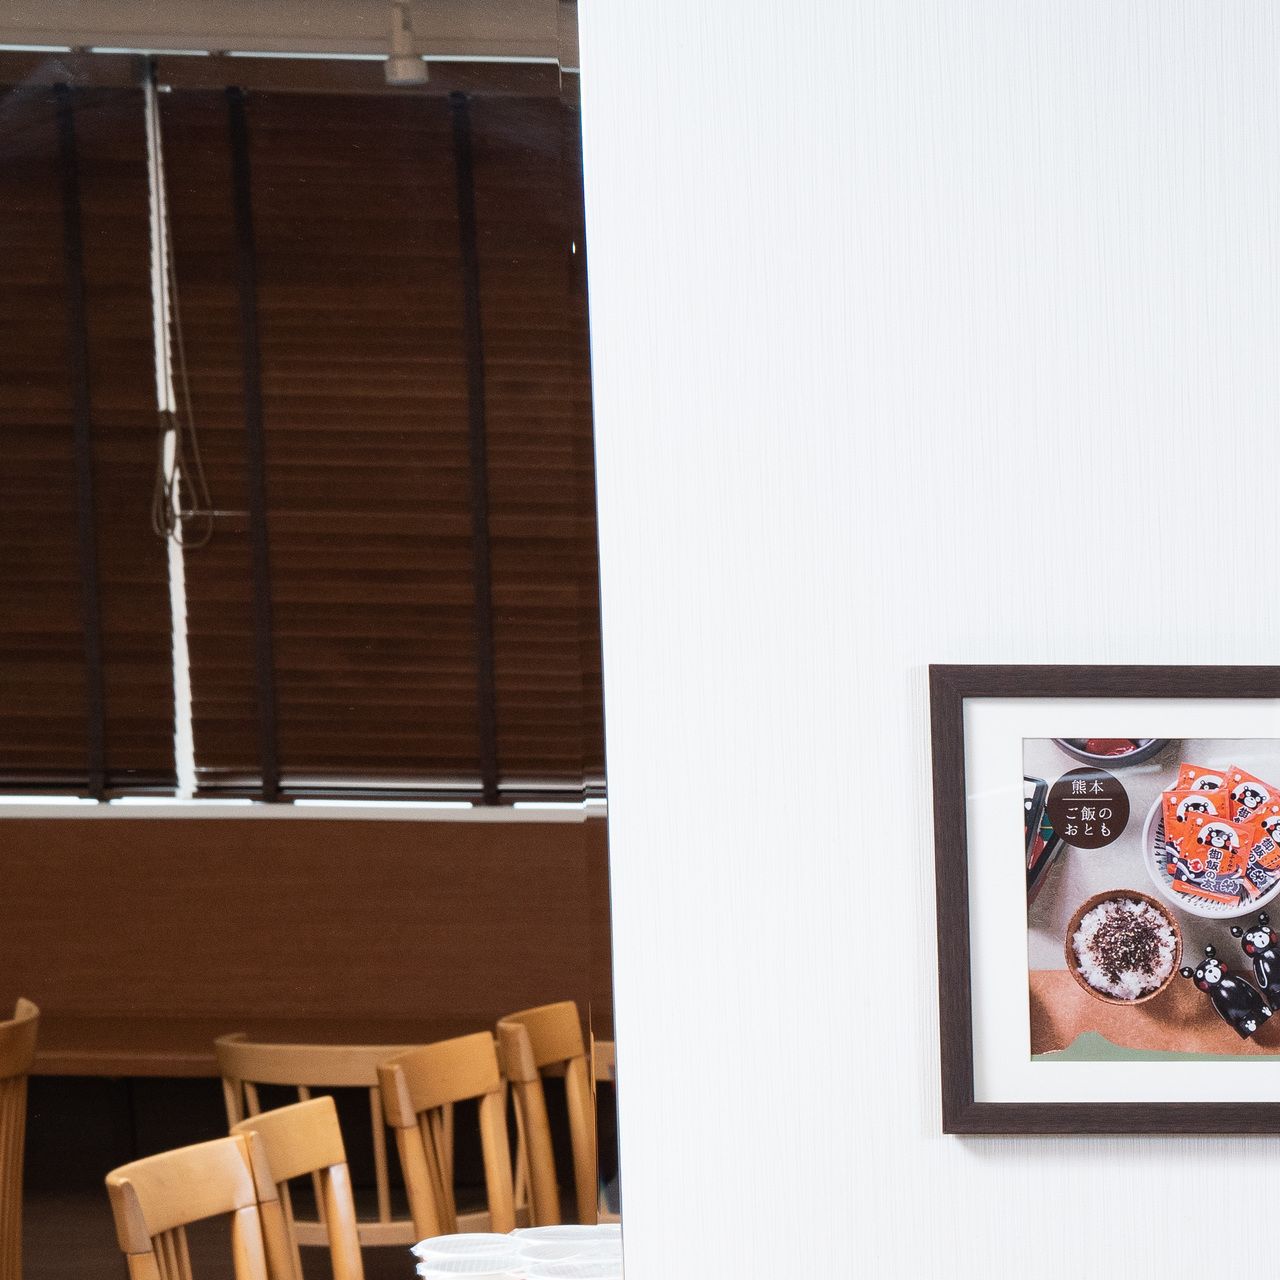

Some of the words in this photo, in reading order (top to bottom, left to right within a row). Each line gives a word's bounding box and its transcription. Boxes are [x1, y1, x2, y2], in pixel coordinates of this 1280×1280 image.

[1071, 779, 1104, 795] 熊本
[1066, 806, 1112, 822] ご飯の
[1065, 823, 1111, 837] おとも
[1201, 848, 1223, 891] 御飯の友
